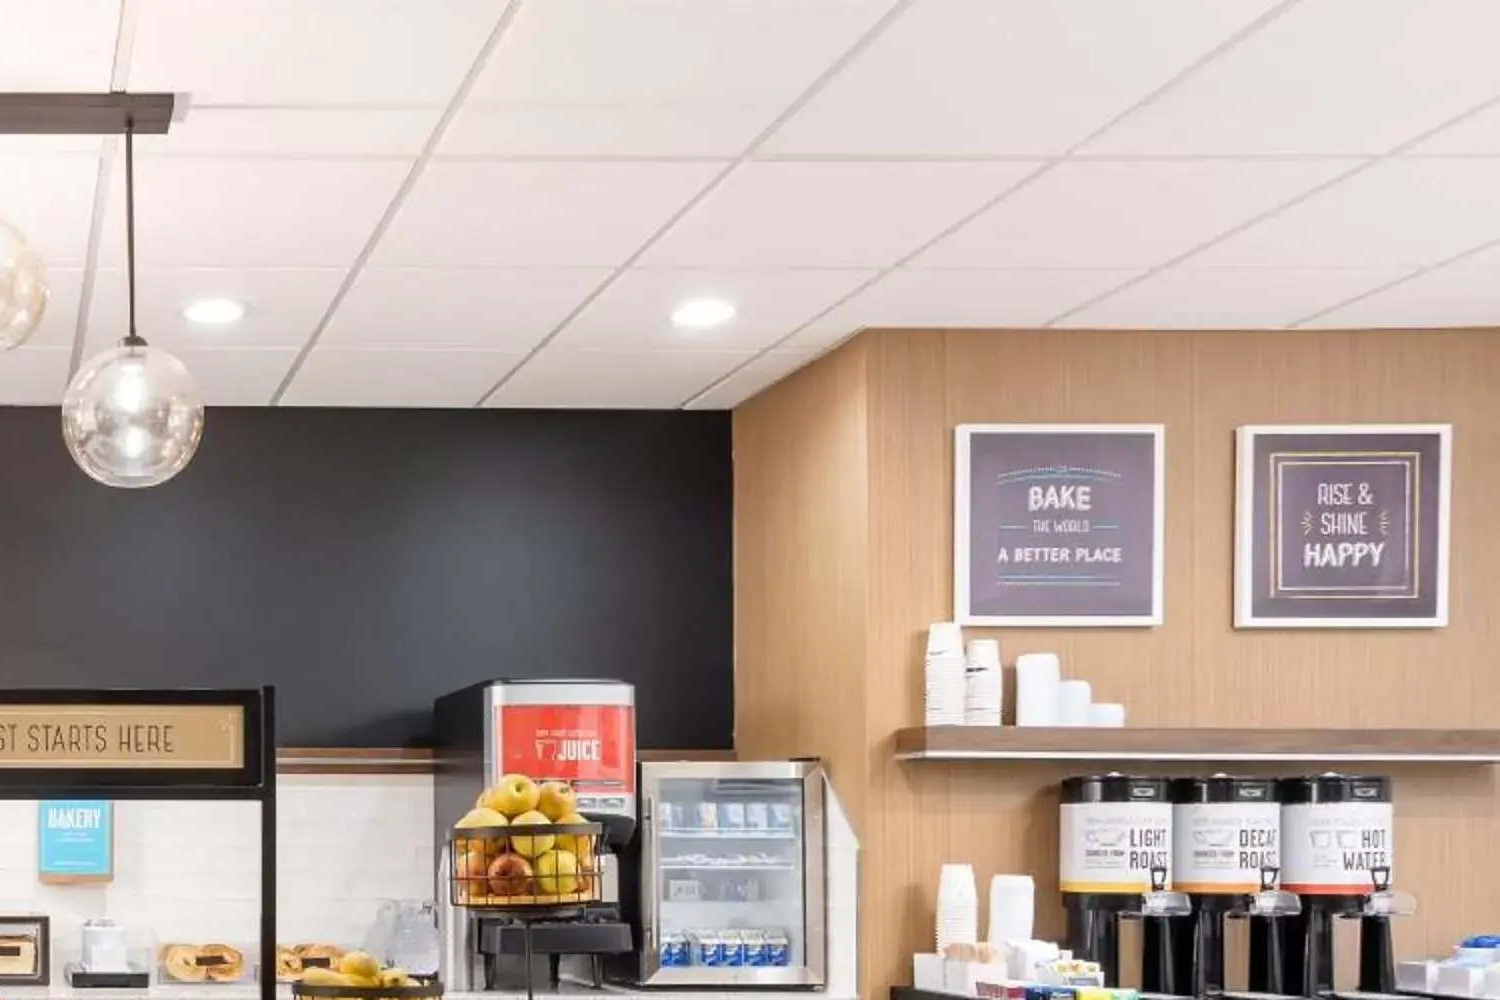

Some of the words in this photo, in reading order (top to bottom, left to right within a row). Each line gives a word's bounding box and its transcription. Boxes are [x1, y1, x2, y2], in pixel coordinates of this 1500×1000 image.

[1028, 484, 1092, 512] BAKE
[1317, 482, 1355, 505] RISE
[1358, 482, 1374, 505] &
[1033, 519, 1051, 533] THE
[1053, 519, 1090, 533] WORLD
[1320, 511, 1369, 535] SHINE
[997, 546, 1009, 563] A
[1014, 546, 1071, 563] BETTER
[1075, 546, 1122, 563] PLACE
[1303, 541, 1386, 567] HAPPY
[27, 724, 108, 752] STARTS
[118, 724, 175, 753] HERE
[557, 738, 601, 761] JUICE
[47, 806, 102, 829] BAKERY
[1129, 828, 1168, 848] LIGHT
[1361, 828, 1387, 849] HOT
[1129, 851, 1168, 870] ROAST
